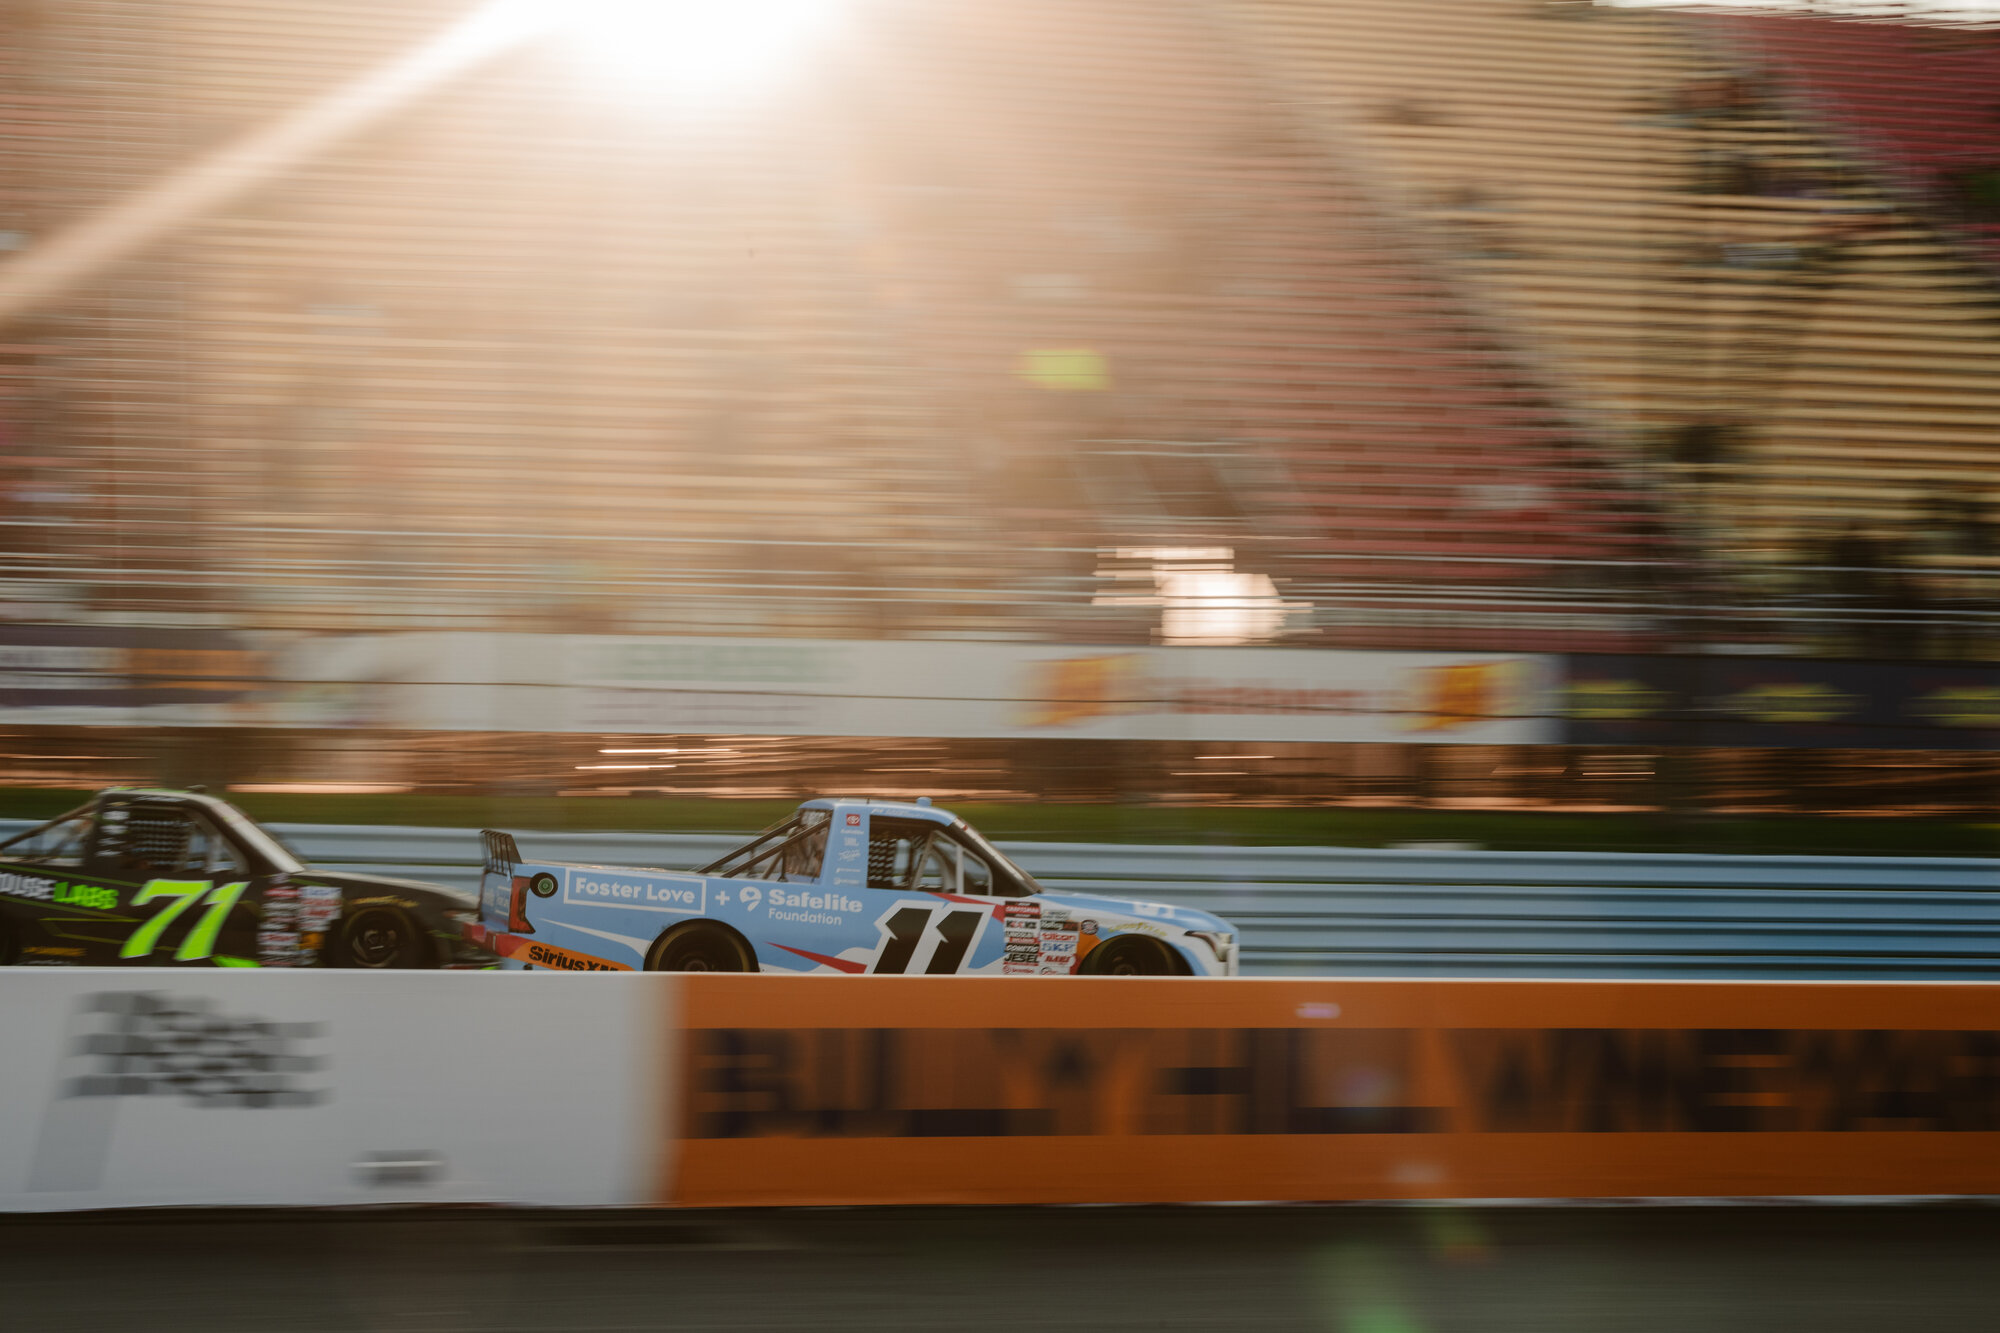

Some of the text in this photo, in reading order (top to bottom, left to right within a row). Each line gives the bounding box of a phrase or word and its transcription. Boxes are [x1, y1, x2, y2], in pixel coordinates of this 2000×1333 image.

[575, 876, 695, 904] Foster Love
[768, 888, 863, 913] Safelite
[119, 878, 251, 961] 71
[768, 908, 842, 926] Foundation
[873, 907, 984, 974] 11
